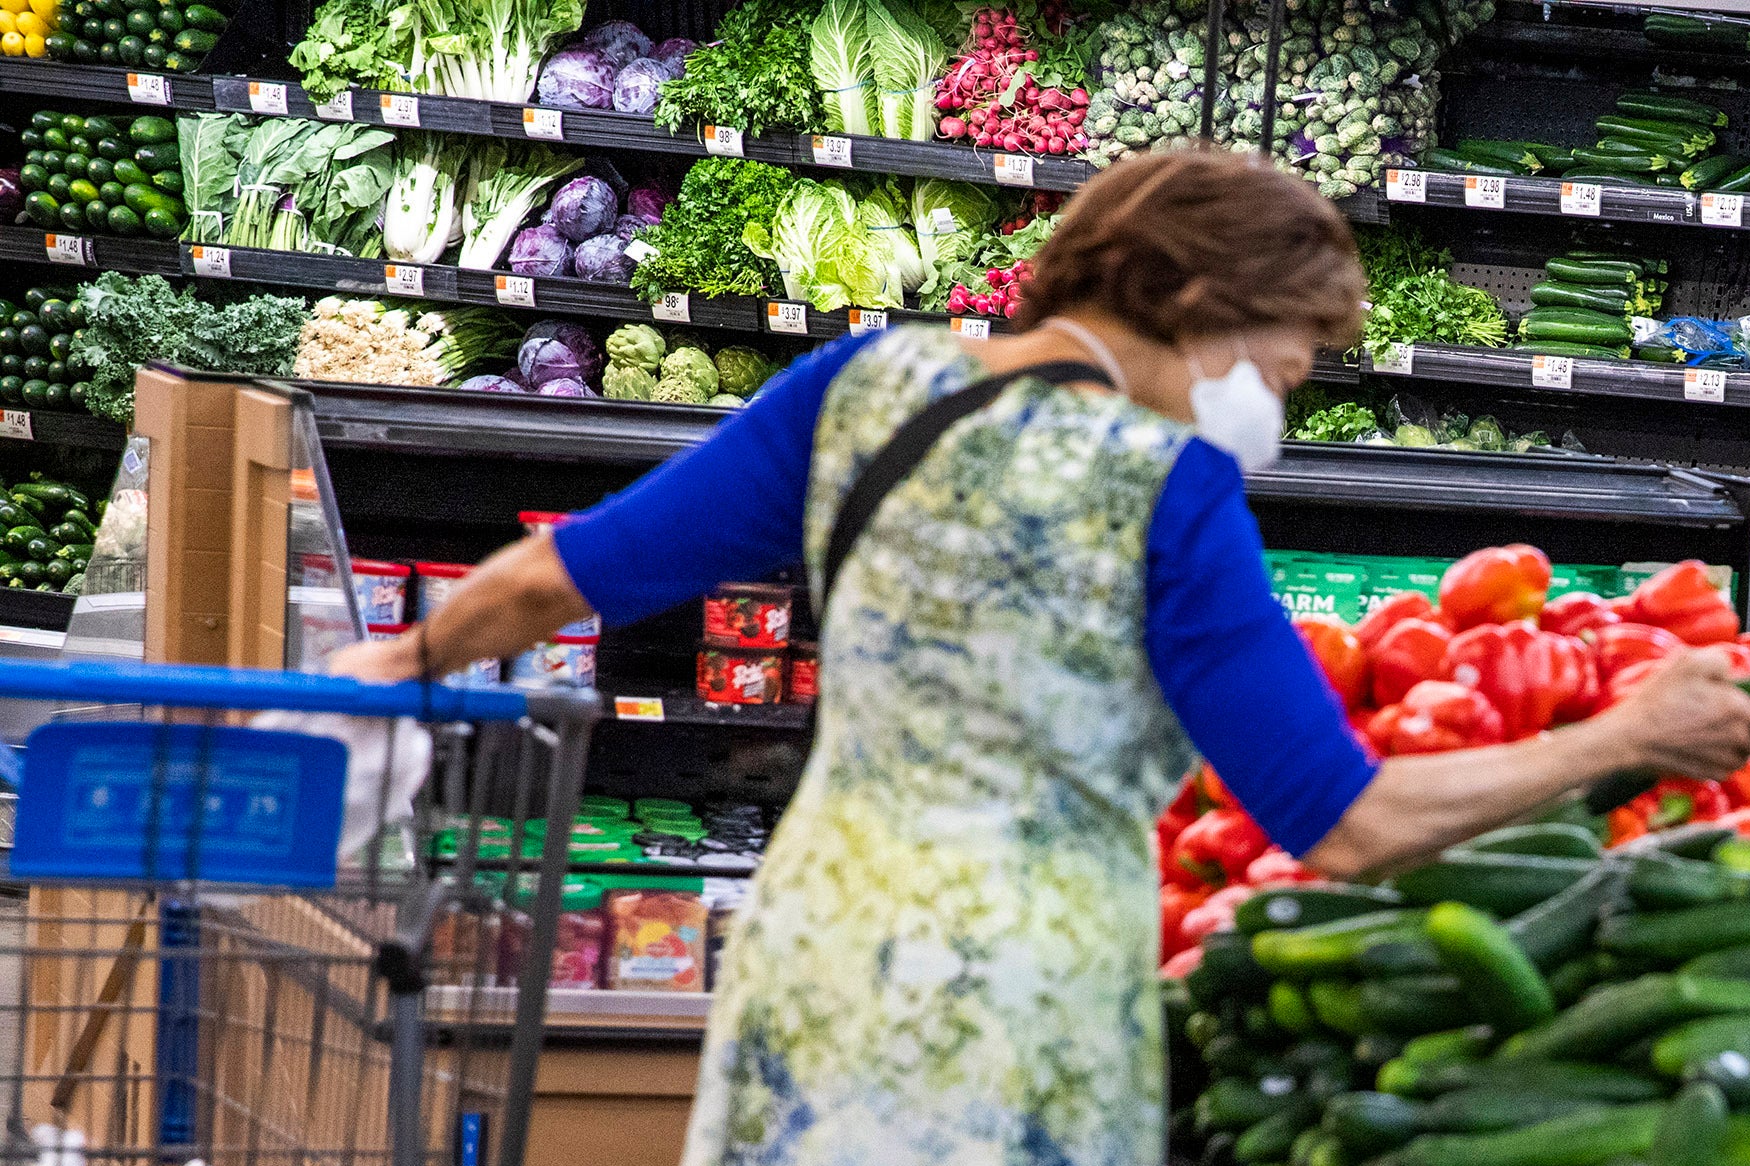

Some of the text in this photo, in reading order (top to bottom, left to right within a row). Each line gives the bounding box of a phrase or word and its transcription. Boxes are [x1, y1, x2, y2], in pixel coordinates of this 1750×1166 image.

[141, 78, 159, 91] $1.48
[826, 139, 845, 153] $3.97
[1008, 158, 1026, 172] $1.37
[1401, 173, 1421, 187] $2.98
[1480, 179, 1500, 193] $2.98
[1576, 187, 1595, 200] $1.48
[1717, 197, 1737, 211] $2.13
[1653, 211, 1674, 222] Mexico
[60, 240, 78, 253] $1.48
[206, 250, 225, 264] $1.24
[399, 269, 418, 283] $2.97
[510, 281, 528, 294] $1.12
[664, 295, 679, 309] 98¢
[782, 307, 800, 320] $3.97
[863, 315, 882, 328] $3.97
[965, 324, 984, 337] $1.37
[1548, 360, 1567, 374] $1.48
[1700, 373, 1720, 387] $2.13
[8, 413, 26, 427] $1.48
